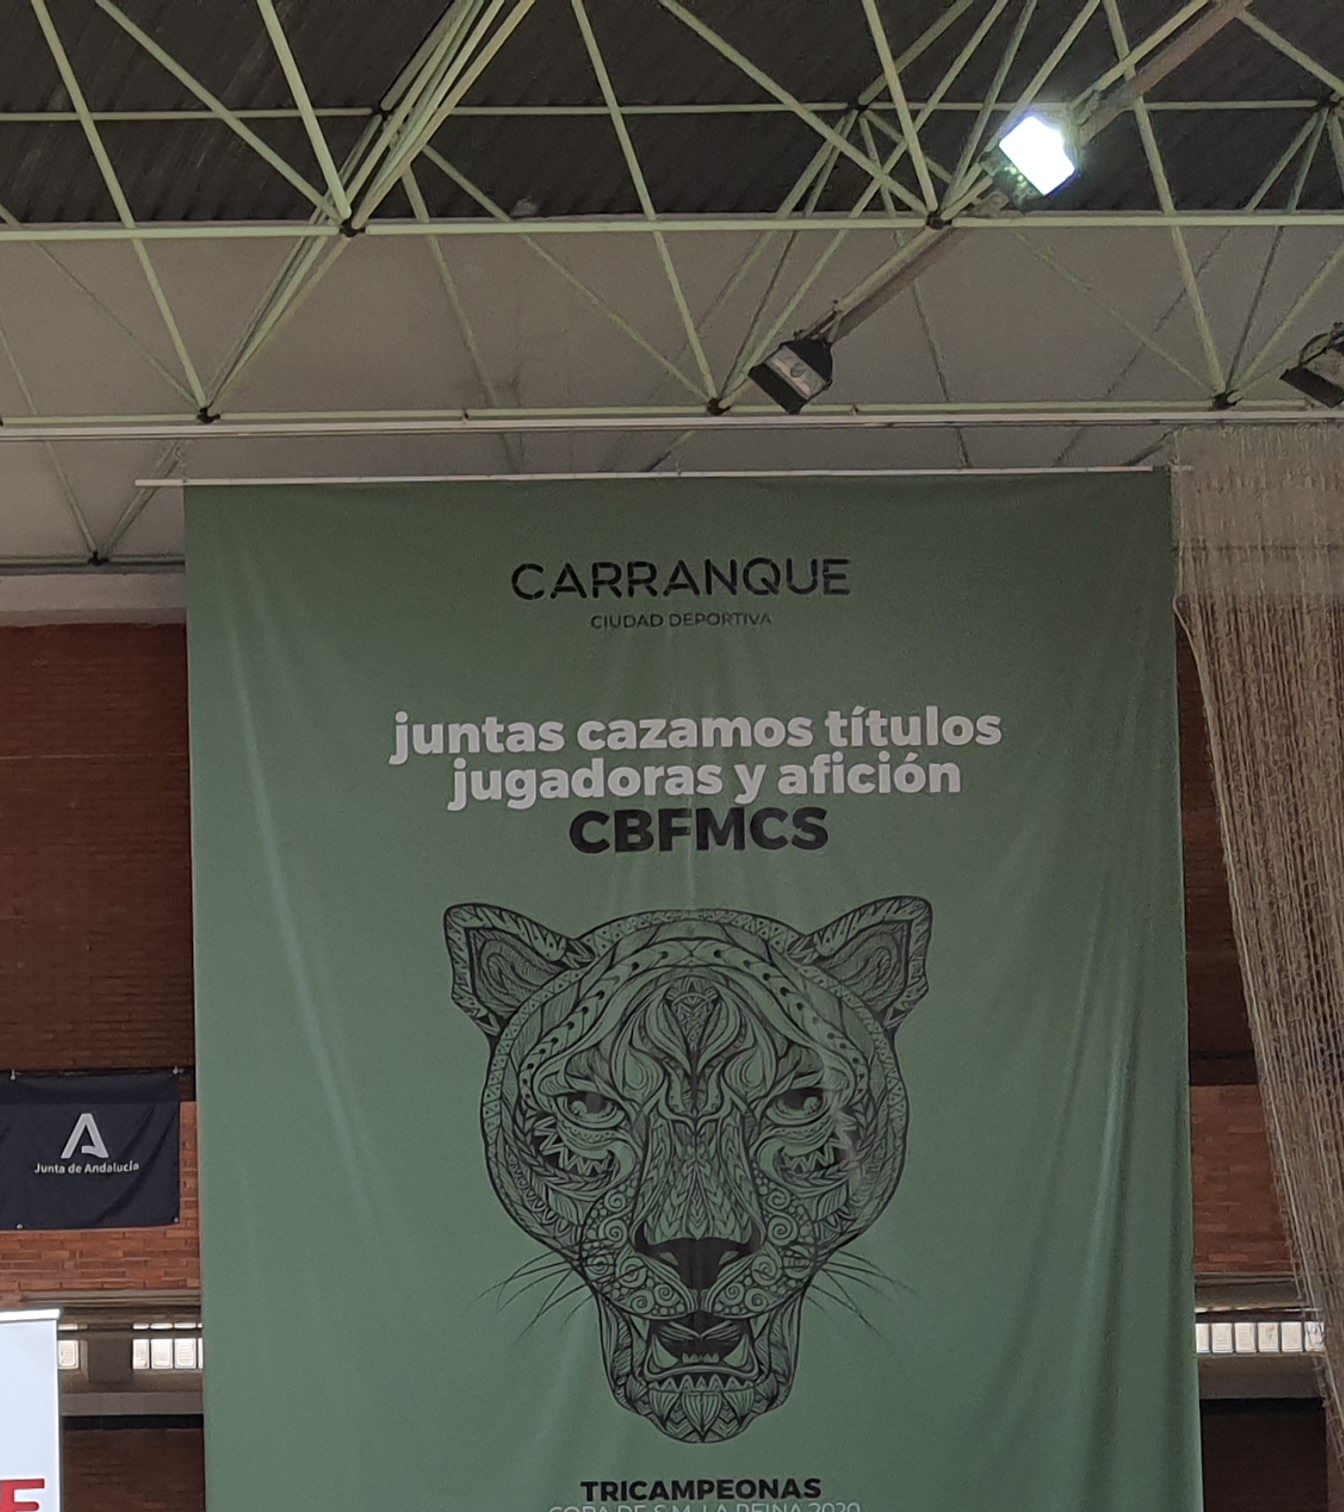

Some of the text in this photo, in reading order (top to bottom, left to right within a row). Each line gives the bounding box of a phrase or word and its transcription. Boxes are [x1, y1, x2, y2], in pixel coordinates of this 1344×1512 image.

[511, 557, 850, 601] CARRANQUE
[591, 611, 772, 629] CIUDAD DEPORTIVA
[389, 705, 1002, 765] juntas cazamos títulos
[447, 753, 961, 811] jugadoras y afición
[569, 807, 829, 854] CBFMCS
[34, 1160, 139, 1176] Junta de Andalucía
[581, 1478, 822, 1502] TRICAMPEONAS
